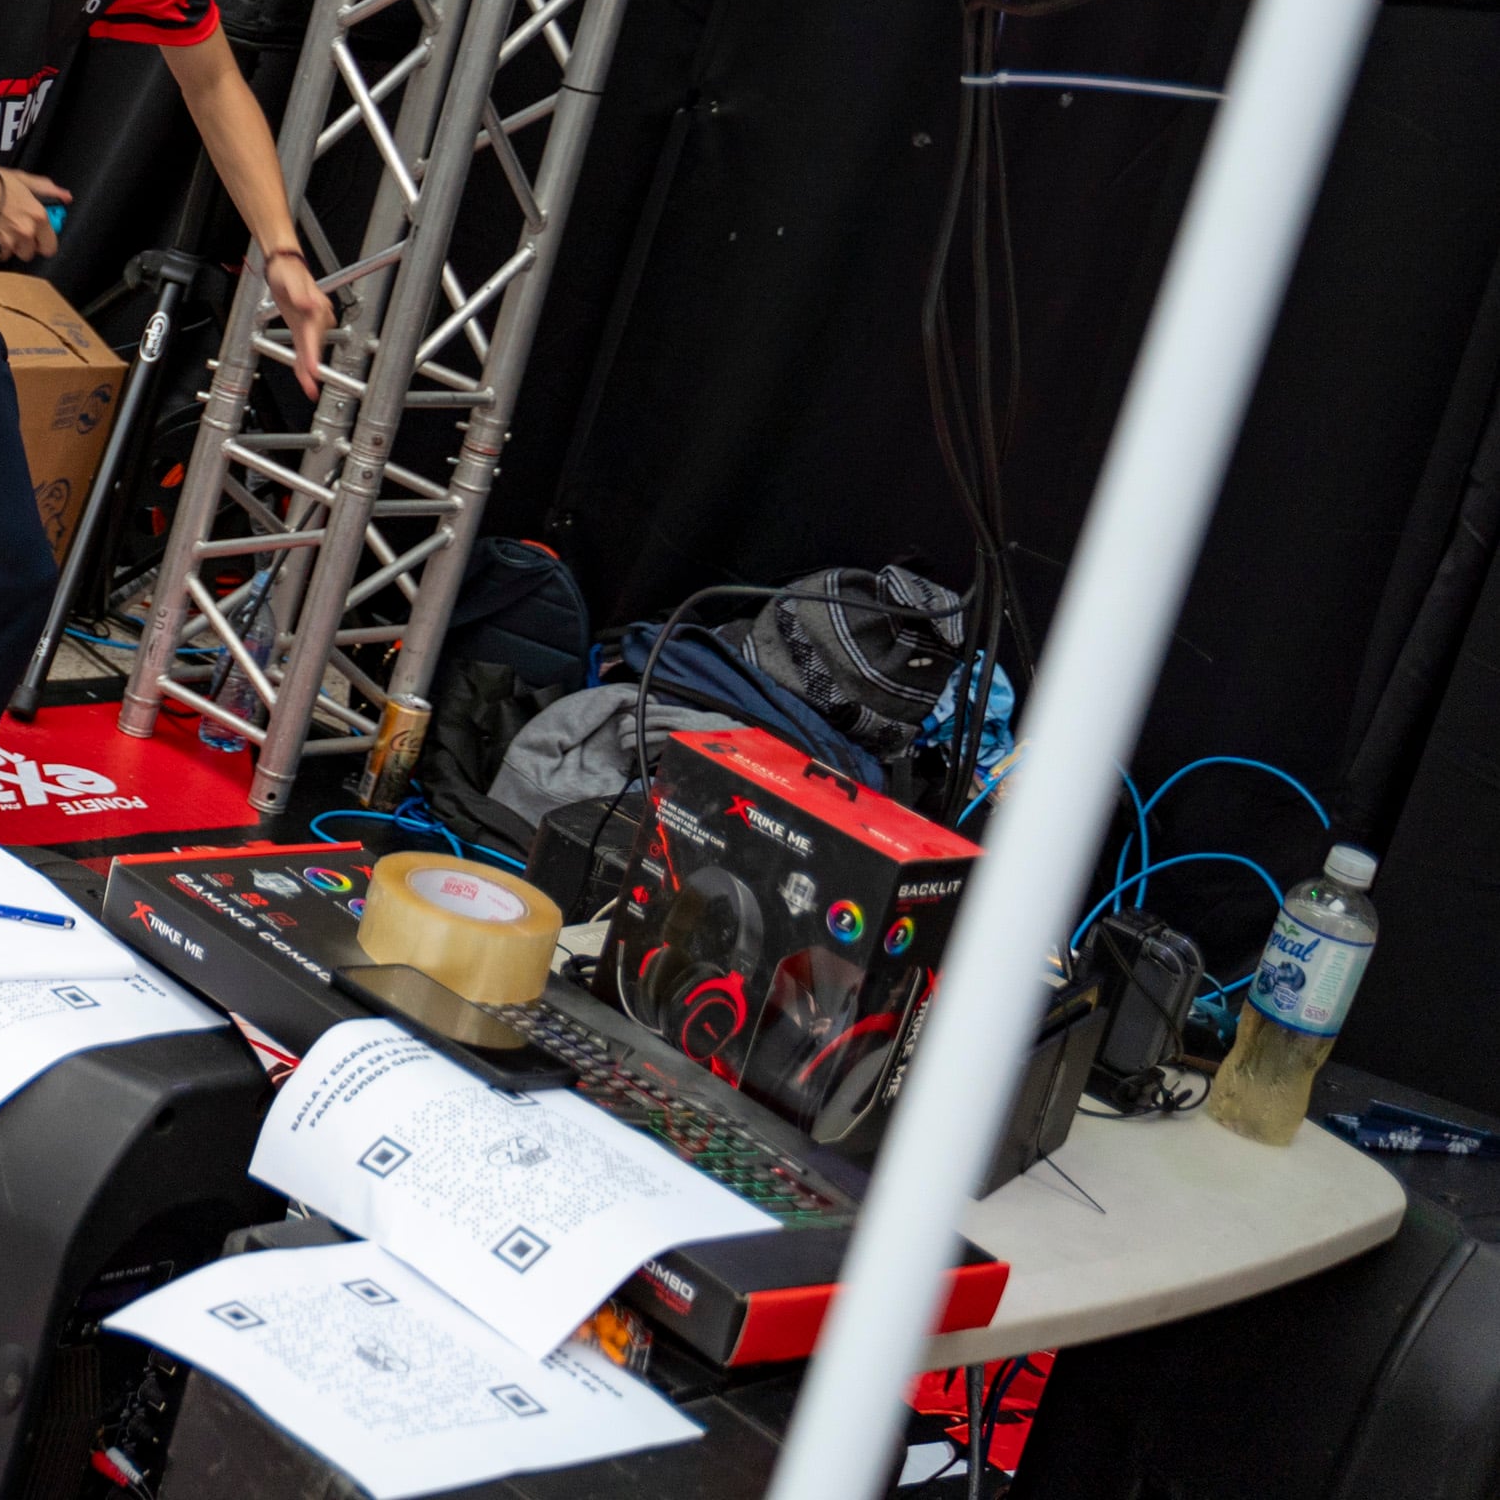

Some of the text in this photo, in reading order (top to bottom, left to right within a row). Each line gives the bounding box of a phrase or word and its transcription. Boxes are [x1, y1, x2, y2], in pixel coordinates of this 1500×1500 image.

[0, 801, 22, 812] FM
[61, 794, 147, 817] PONETE
[787, 829, 812, 852] ME
[174, 872, 257, 930] GAMING
[897, 879, 963, 898] BACKLIT
[183, 935, 205, 961] ME
[308, 1065, 368, 1129] PARTICIPA
[343, 1065, 391, 1103] COMBOS
[290, 1089, 321, 1132] BAILA
